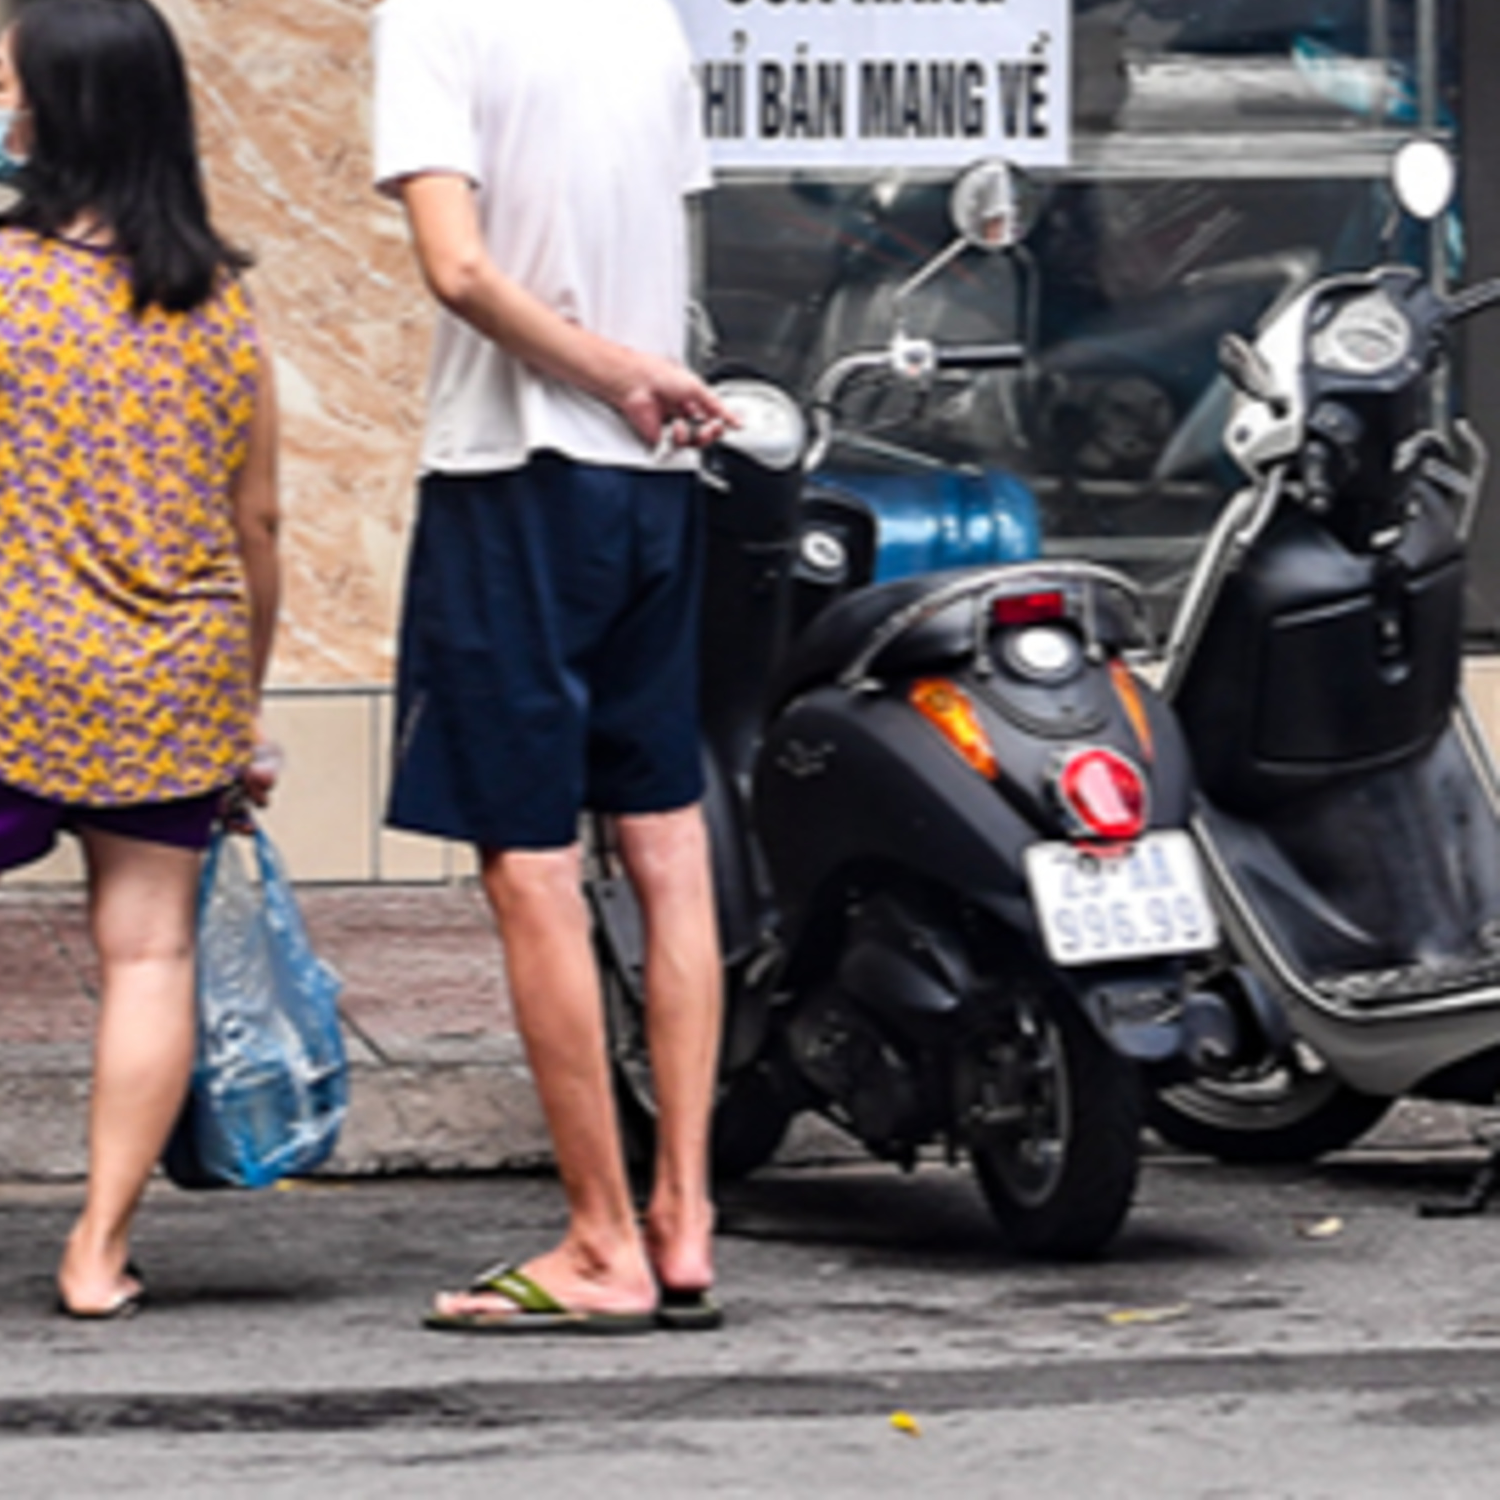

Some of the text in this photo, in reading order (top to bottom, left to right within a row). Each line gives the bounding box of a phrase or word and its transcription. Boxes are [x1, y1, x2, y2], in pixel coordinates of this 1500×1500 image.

[690, 30, 746, 138] HỈ
[758, 42, 845, 138] BÁN
[859, 61, 985, 138] MANG
